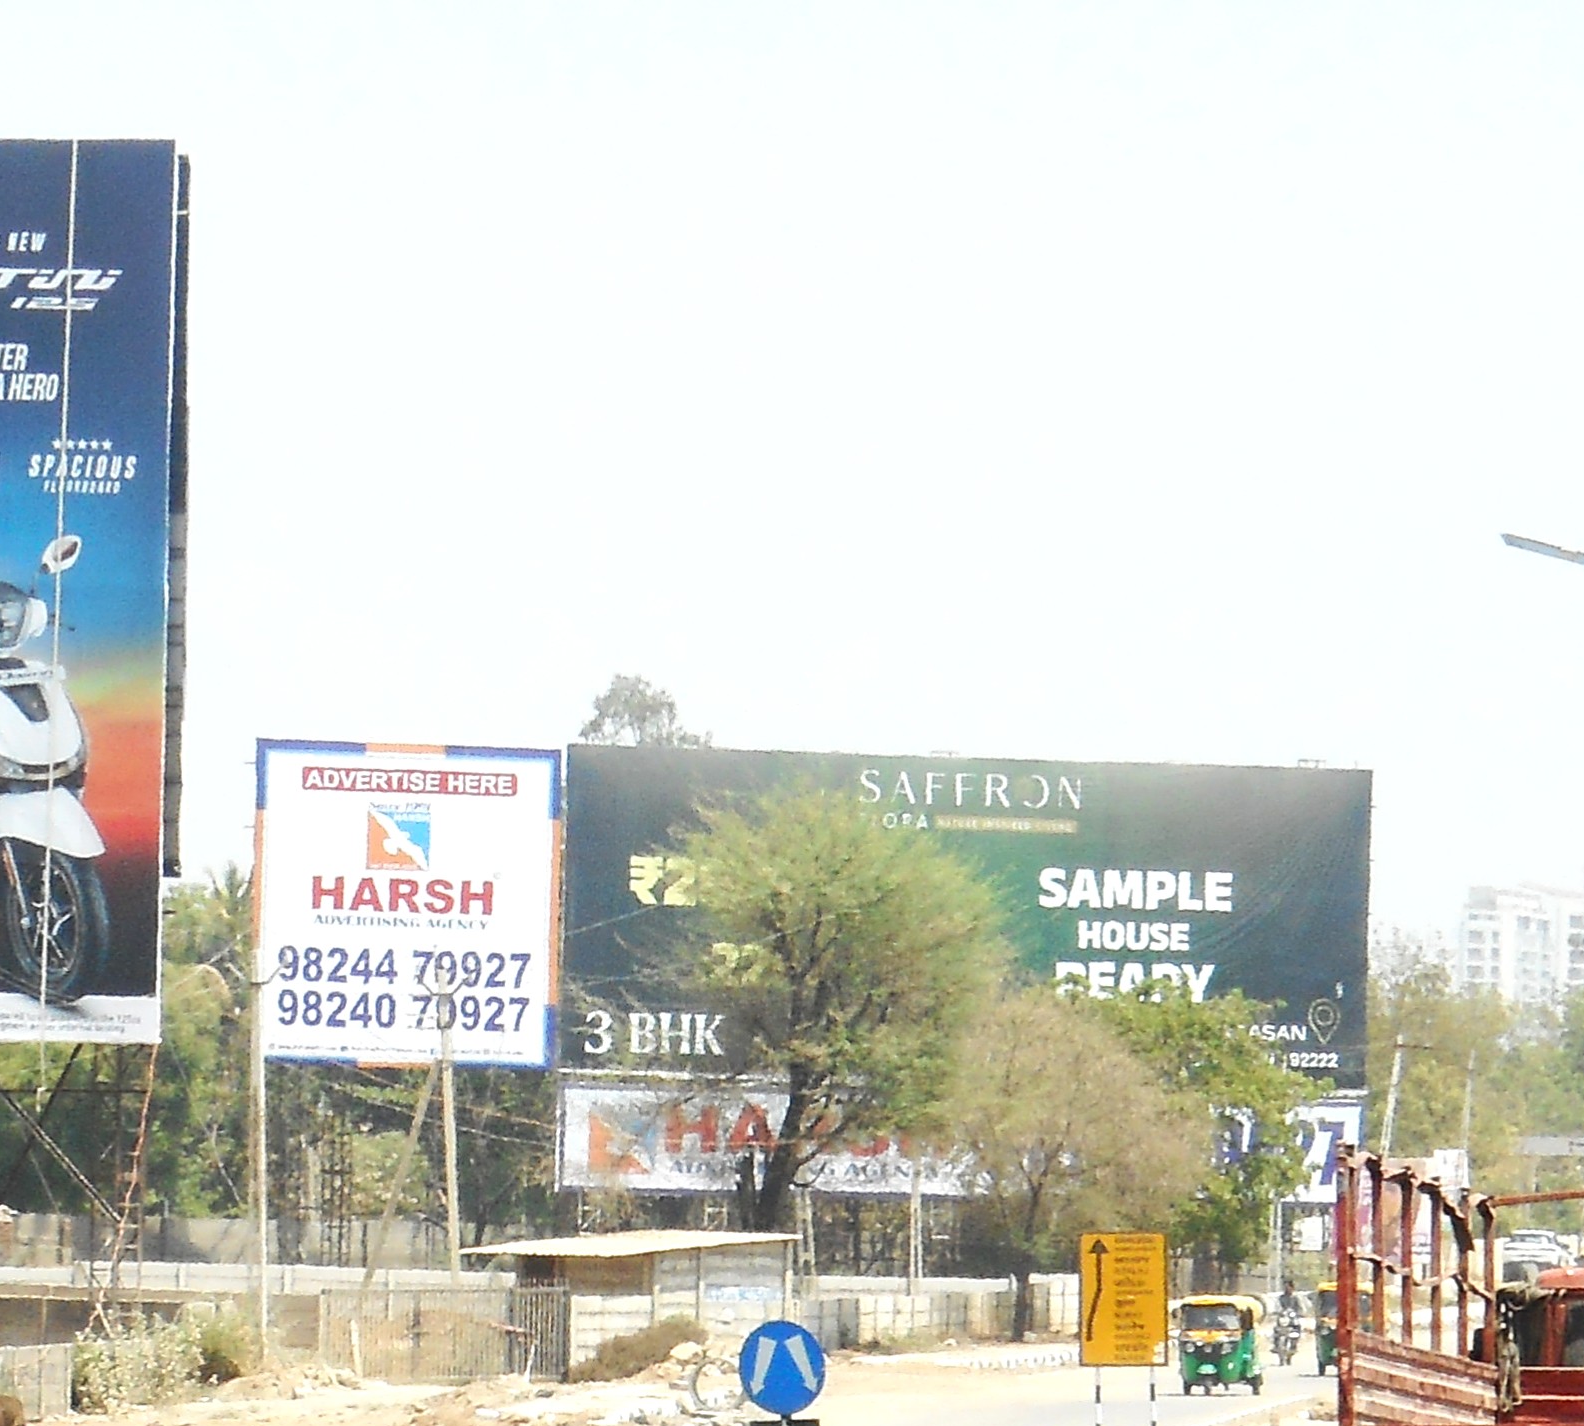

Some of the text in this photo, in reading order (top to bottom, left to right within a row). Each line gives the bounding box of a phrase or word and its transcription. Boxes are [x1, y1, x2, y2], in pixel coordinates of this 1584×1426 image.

[6, 232, 47, 253] NEW
[10, 296, 100, 311] 125
[8, 373, 59, 402] HERO
[28, 454, 138, 480] SPACIOUS
[304, 769, 514, 795] ADVERTISE HERE
[858, 768, 1083, 810] SAFFRON
[311, 875, 494, 916] HARSH
[1037, 866, 1235, 913] SAMPLE
[313, 914, 490, 931] ADVERTISING AGENCY
[1076, 919, 1191, 952] HOUSE
[277, 944, 398, 985] 98244
[276, 989, 397, 1029] 98240
[583, 1009, 726, 1057] 3 BHK
